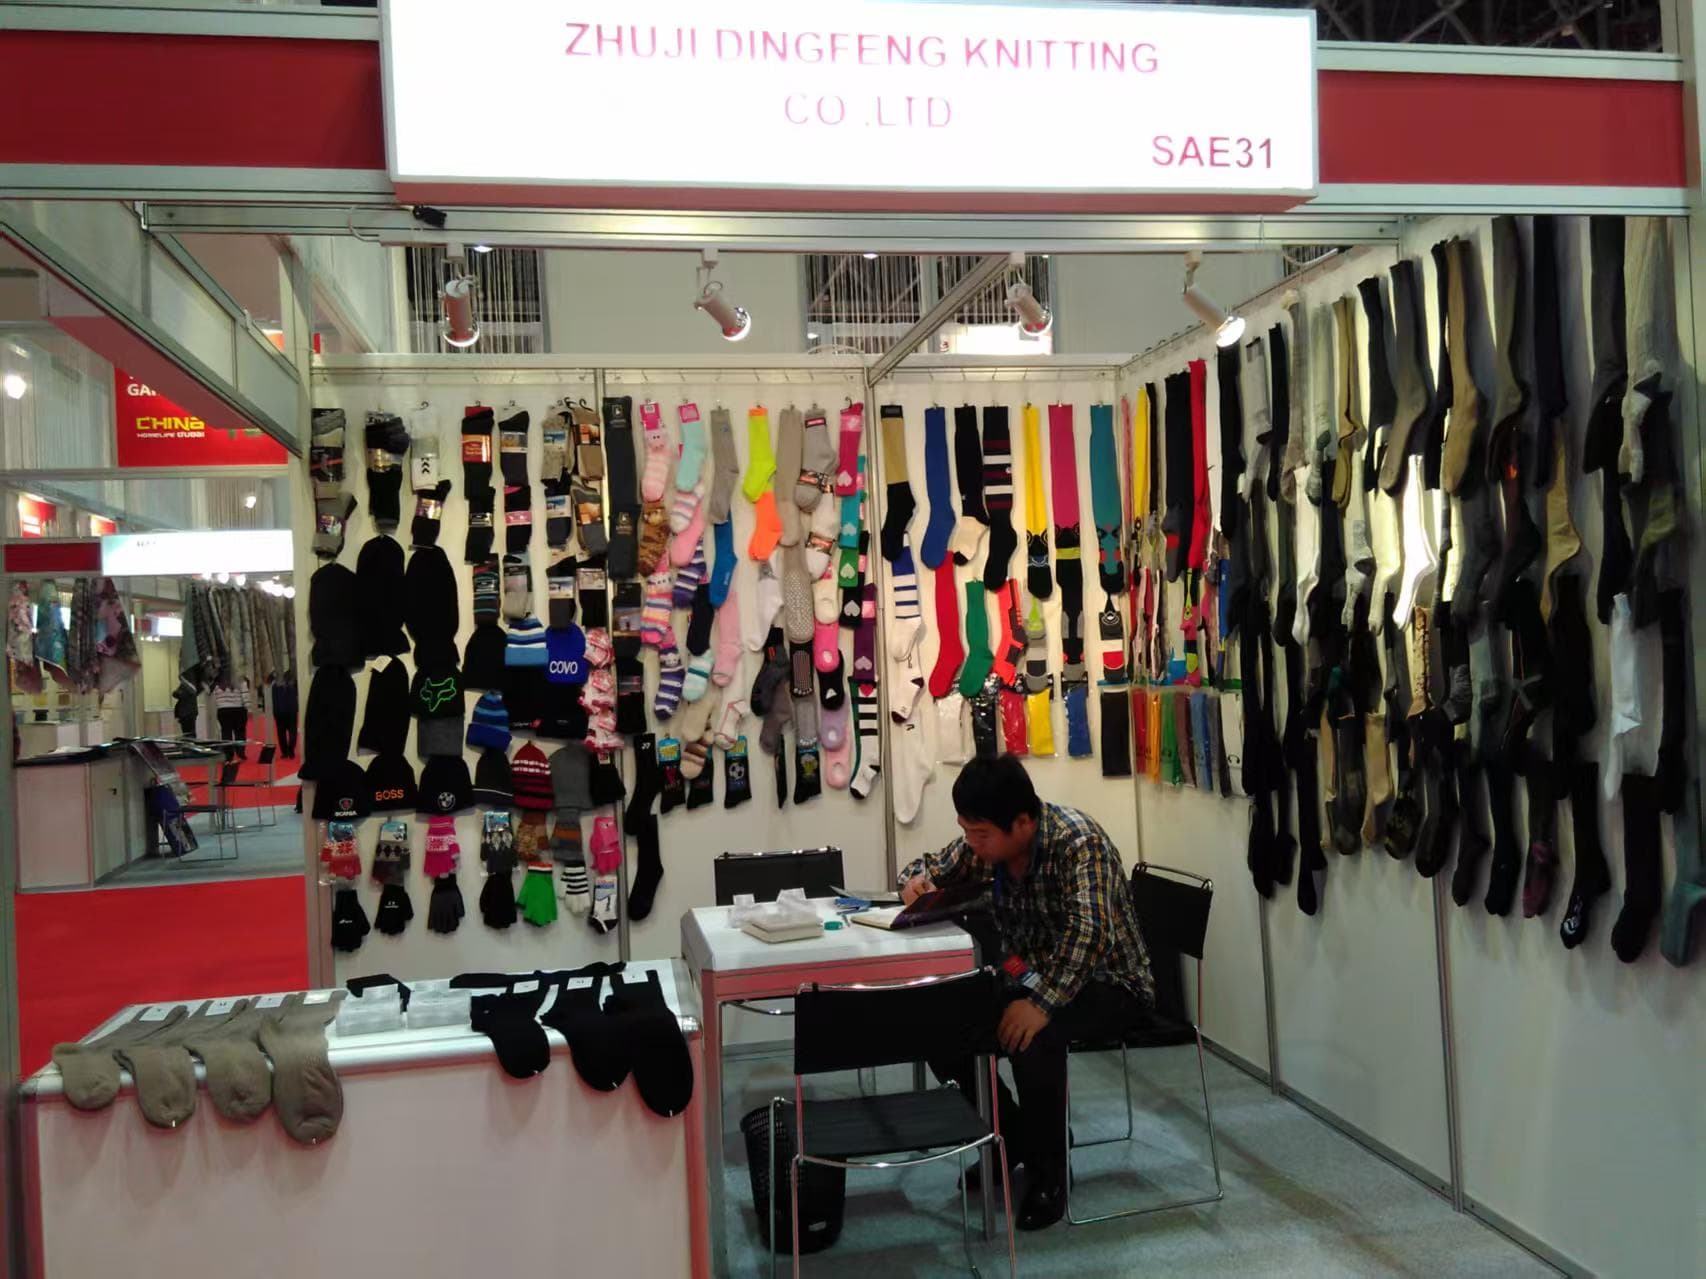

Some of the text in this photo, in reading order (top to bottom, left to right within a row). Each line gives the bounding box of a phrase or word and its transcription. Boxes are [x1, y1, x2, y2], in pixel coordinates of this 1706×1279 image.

[565, 22, 1160, 73] ZHUJI DINGFENG KNITTING
[784, 94, 846, 125] CO
[1151, 135, 1272, 169] SAE31
[549, 660, 578, 675] COVO
[375, 789, 405, 802] BOSS
